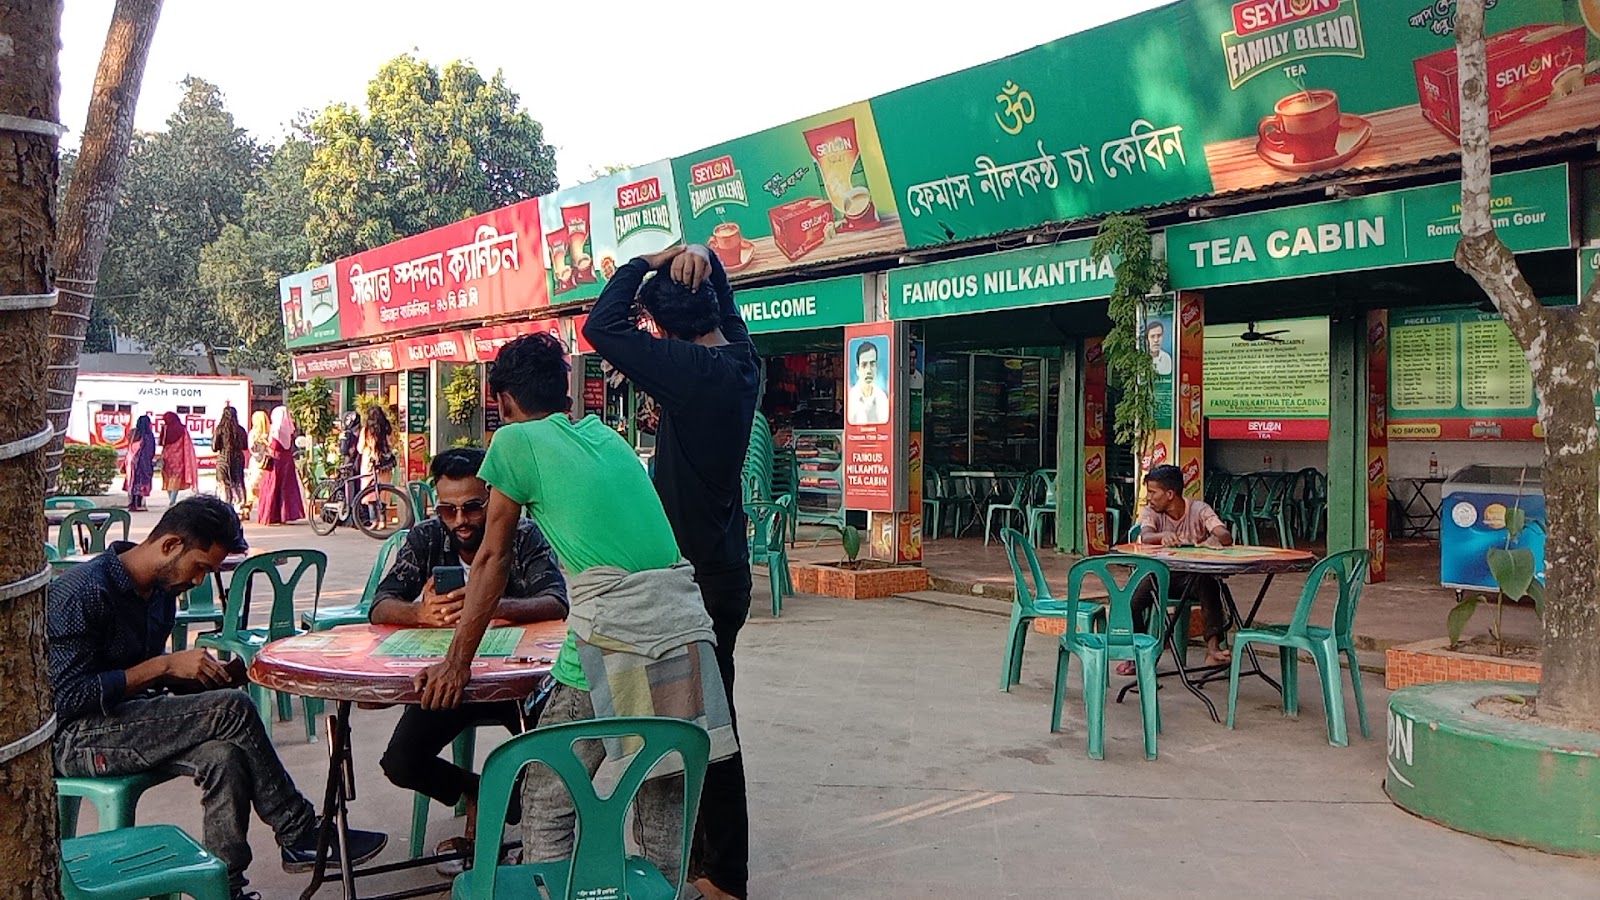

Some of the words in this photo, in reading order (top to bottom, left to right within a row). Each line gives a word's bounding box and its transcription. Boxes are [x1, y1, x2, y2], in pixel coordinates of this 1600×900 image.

[1242, 0, 1331, 30] SEYLON
[1227, 31, 1290, 81] FAMILY
[1293, 15, 1358, 50] BLEND
[1283, 65, 1307, 78] TEA
[1496, 54, 1552, 88] SEYLON
[694, 162, 731, 183] SEYLON
[908, 174, 975, 217] ফেমাস
[1061, 144, 1095, 184] চা
[1100, 118, 1186, 178] কেবিন
[620, 183, 658, 206] SEYLON
[690, 187, 717, 212] FAMILY
[717, 180, 745, 200] BLEND
[615, 210, 641, 239] FAMILY
[642, 205, 670, 228] BLEND
[1513, 211, 1546, 226] Gour
[1189, 236, 1256, 268] TEA
[1266, 216, 1386, 259] CABIN
[349, 263, 392, 305] সীমান্ত
[393, 252, 444, 293] স্পন্দন
[447, 224, 520, 283] ক্যান্টিন
[902, 275, 978, 305] FAMOUS
[984, 255, 1115, 295] NILKANTHA
[739, 295, 816, 323] WELCOME
[1404, 317, 1425, 325] PRICE
[1426, 316, 1441, 324] LIST
[424, 341, 458, 360] CANTEEN
[137, 387, 168, 397] WASH
[172, 388, 202, 397] ROOM
[1248, 421, 1282, 431] SEYLON
[1391, 425, 1402, 434] NO
[1404, 425, 1437, 434] SMOKING
[852, 453, 883, 463] FAMOUS
[847, 464, 889, 475] NILKANTHA
[848, 475, 863, 485] TEA
[863, 476, 888, 486] CABIN
